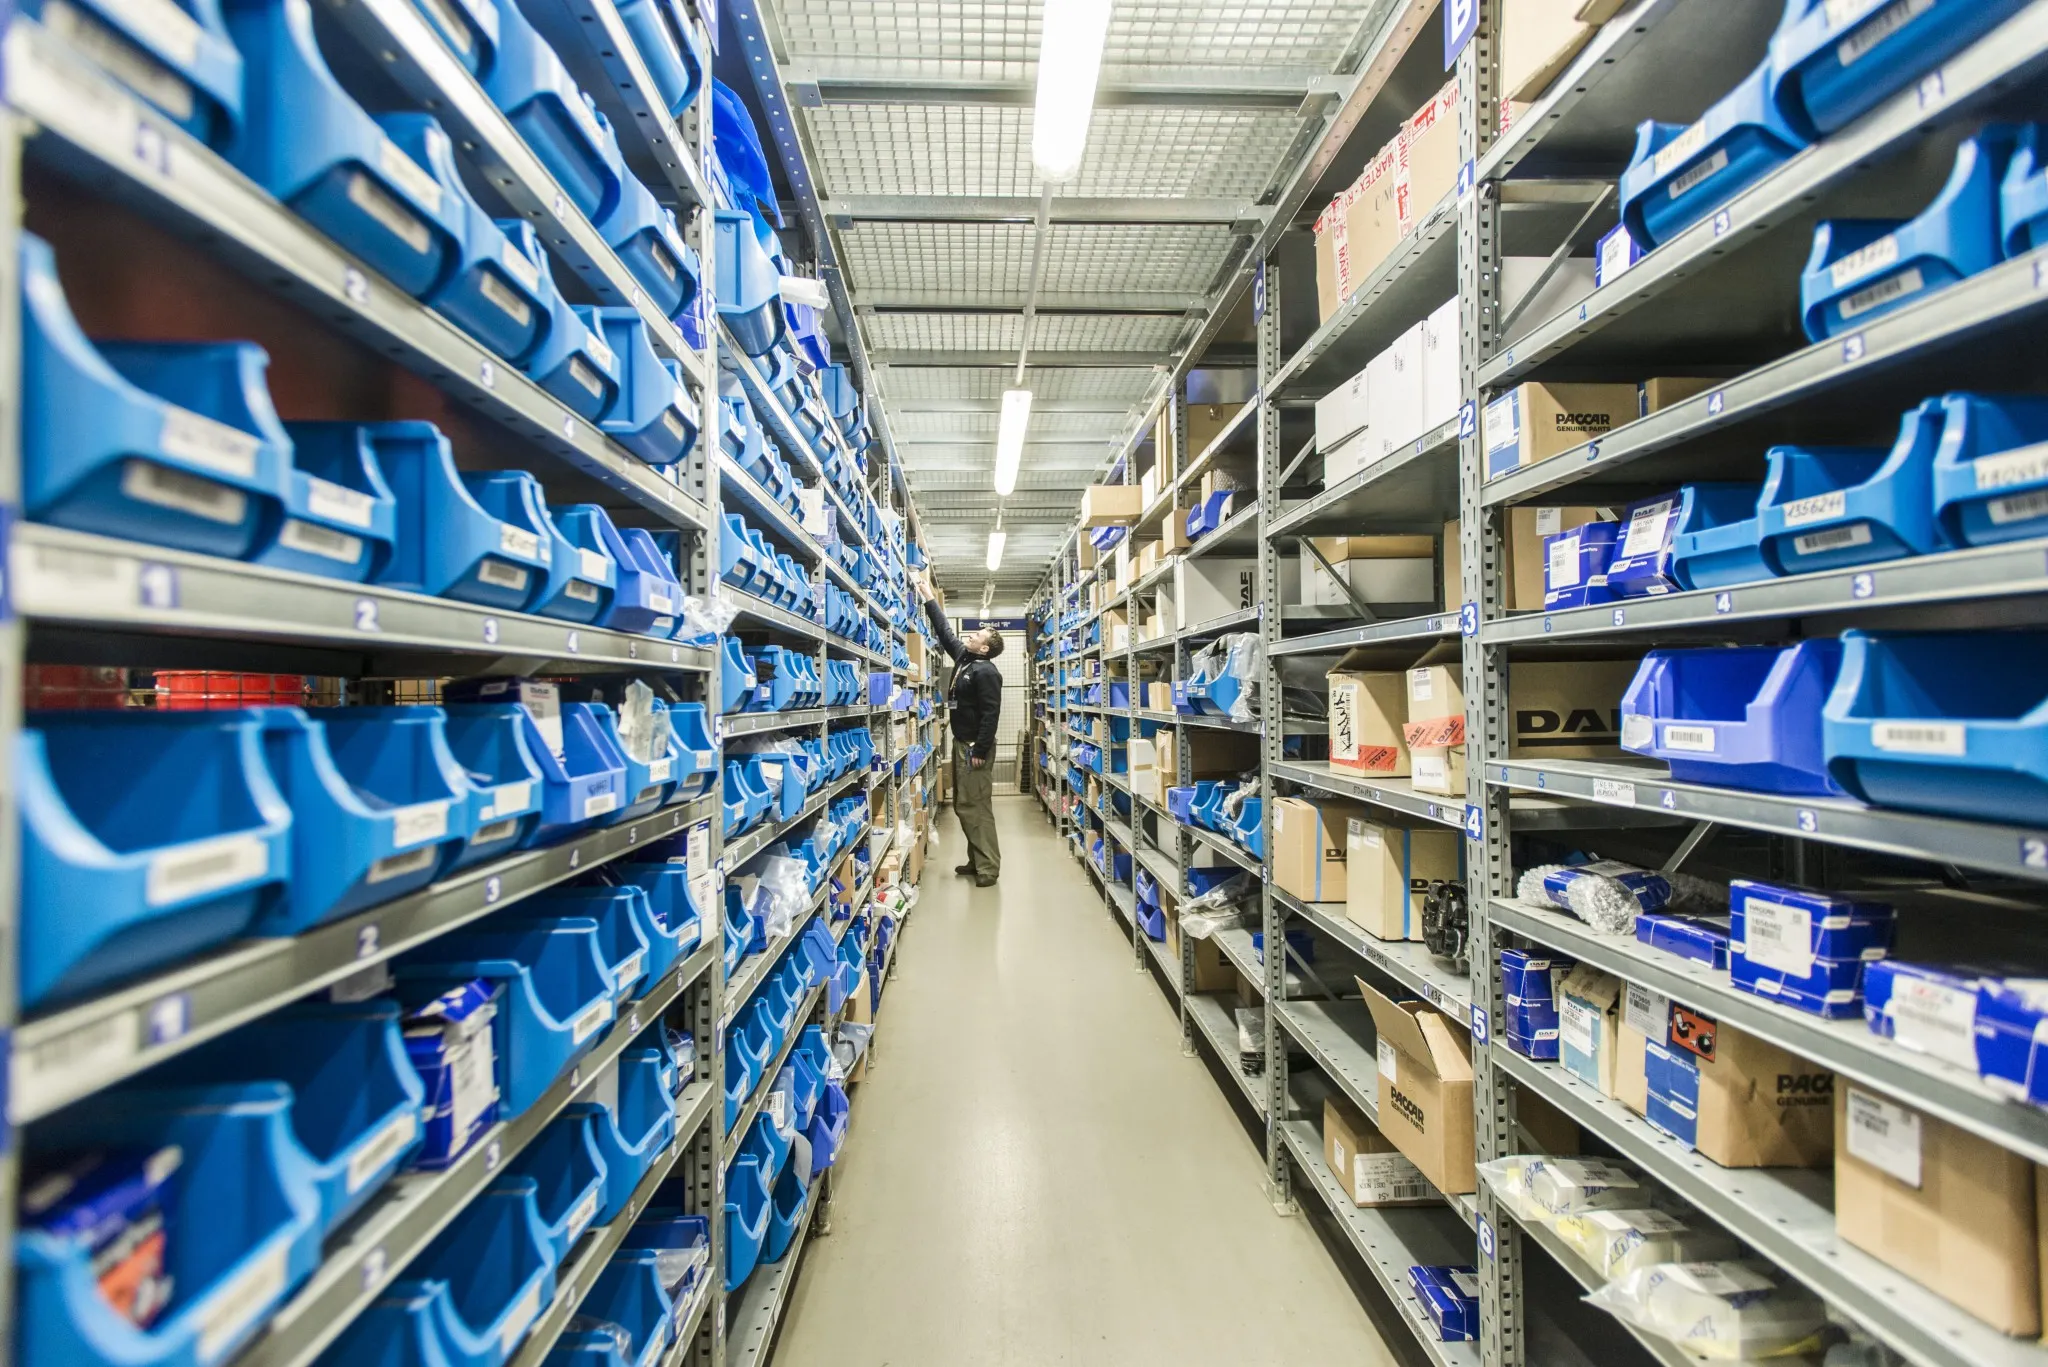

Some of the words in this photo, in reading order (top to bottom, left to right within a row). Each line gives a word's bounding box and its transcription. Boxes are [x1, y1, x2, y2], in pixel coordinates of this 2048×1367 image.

[704, 154, 712, 186] 1
[1459, 166, 1471, 194] 1
[1713, 212, 1731, 236] 3
[347, 270, 369, 304] 2
[1254, 278, 1264, 312] C
[707, 292, 717, 326] 2
[1579, 303, 1588, 322] 4
[1507, 350, 1515, 367] 5
[1845, 335, 1865, 362] 3
[481, 361, 495, 388] 3
[1709, 392, 1724, 413] 4
[1461, 404, 1474, 438] 2
[1555, 413, 1610, 425] PACCAR
[1588, 425, 1612, 433] PARTS
[1417, 441, 1423, 453] 1
[1633, 507, 1656, 518] DAF
[1613, 562, 1627, 570] DAF
[152, 566, 174, 607] 1
[1240, 571, 1250, 611] DAF
[1855, 574, 1874, 598] 3
[1259, 602, 1265, 621] 3
[1717, 593, 1731, 612] 4
[357, 602, 377, 631] 2
[1426, 619, 1432, 631] 1
[1463, 605, 1476, 635] 3
[1544, 617, 1552, 633] 6
[1614, 609, 1624, 626] 5
[484, 619, 498, 643] 3
[1359, 630, 1364, 641] 2
[567, 631, 578, 652] 4
[630, 644, 637, 658] 5
[671, 647, 679, 662] 6
[715, 717, 722, 743] 5
[729, 720, 735, 732] 1
[751, 718, 757, 729] 2
[1261, 720, 1266, 738] 4
[1437, 719, 1459, 744] DAF
[1501, 767, 1508, 782] 6
[1538, 772, 1545, 788] 5
[1375, 790, 1381, 801] 2
[1663, 791, 1675, 809] 4
[673, 812, 679, 826] 6
[1428, 804, 1434, 816] 1
[1800, 809, 1816, 831] 3
[1467, 807, 1481, 838] 4
[629, 827, 637, 843] 5
[569, 849, 579, 867] 4
[2023, 840, 2047, 867] 2
[716, 861, 723, 891] 6
[1262, 866, 1268, 884] 5
[486, 877, 500, 902] 3
[360, 930, 378, 958] 2
[1361, 945, 1367, 955] 2
[677, 973, 682, 987] 6
[1423, 984, 1429, 997] 1
[1567, 1001, 1584, 1014] DAF
[630, 1015, 639, 1033] 5
[717, 1018, 725, 1050] 7
[1473, 1008, 1486, 1040] 5
[571, 1067, 579, 1088] 4
[1390, 1085, 1425, 1126] PACCAR
[1266, 1111, 1272, 1131] 7
[1391, 1100, 1411, 1124] GENUINE
[1410, 1118, 1425, 1135] PARTS
[487, 1142, 501, 1170] 3
[671, 1140, 678, 1157] 6
[717, 1159, 725, 1193] 8
[1479, 1220, 1492, 1255] 6
[717, 1302, 725, 1338] 9
